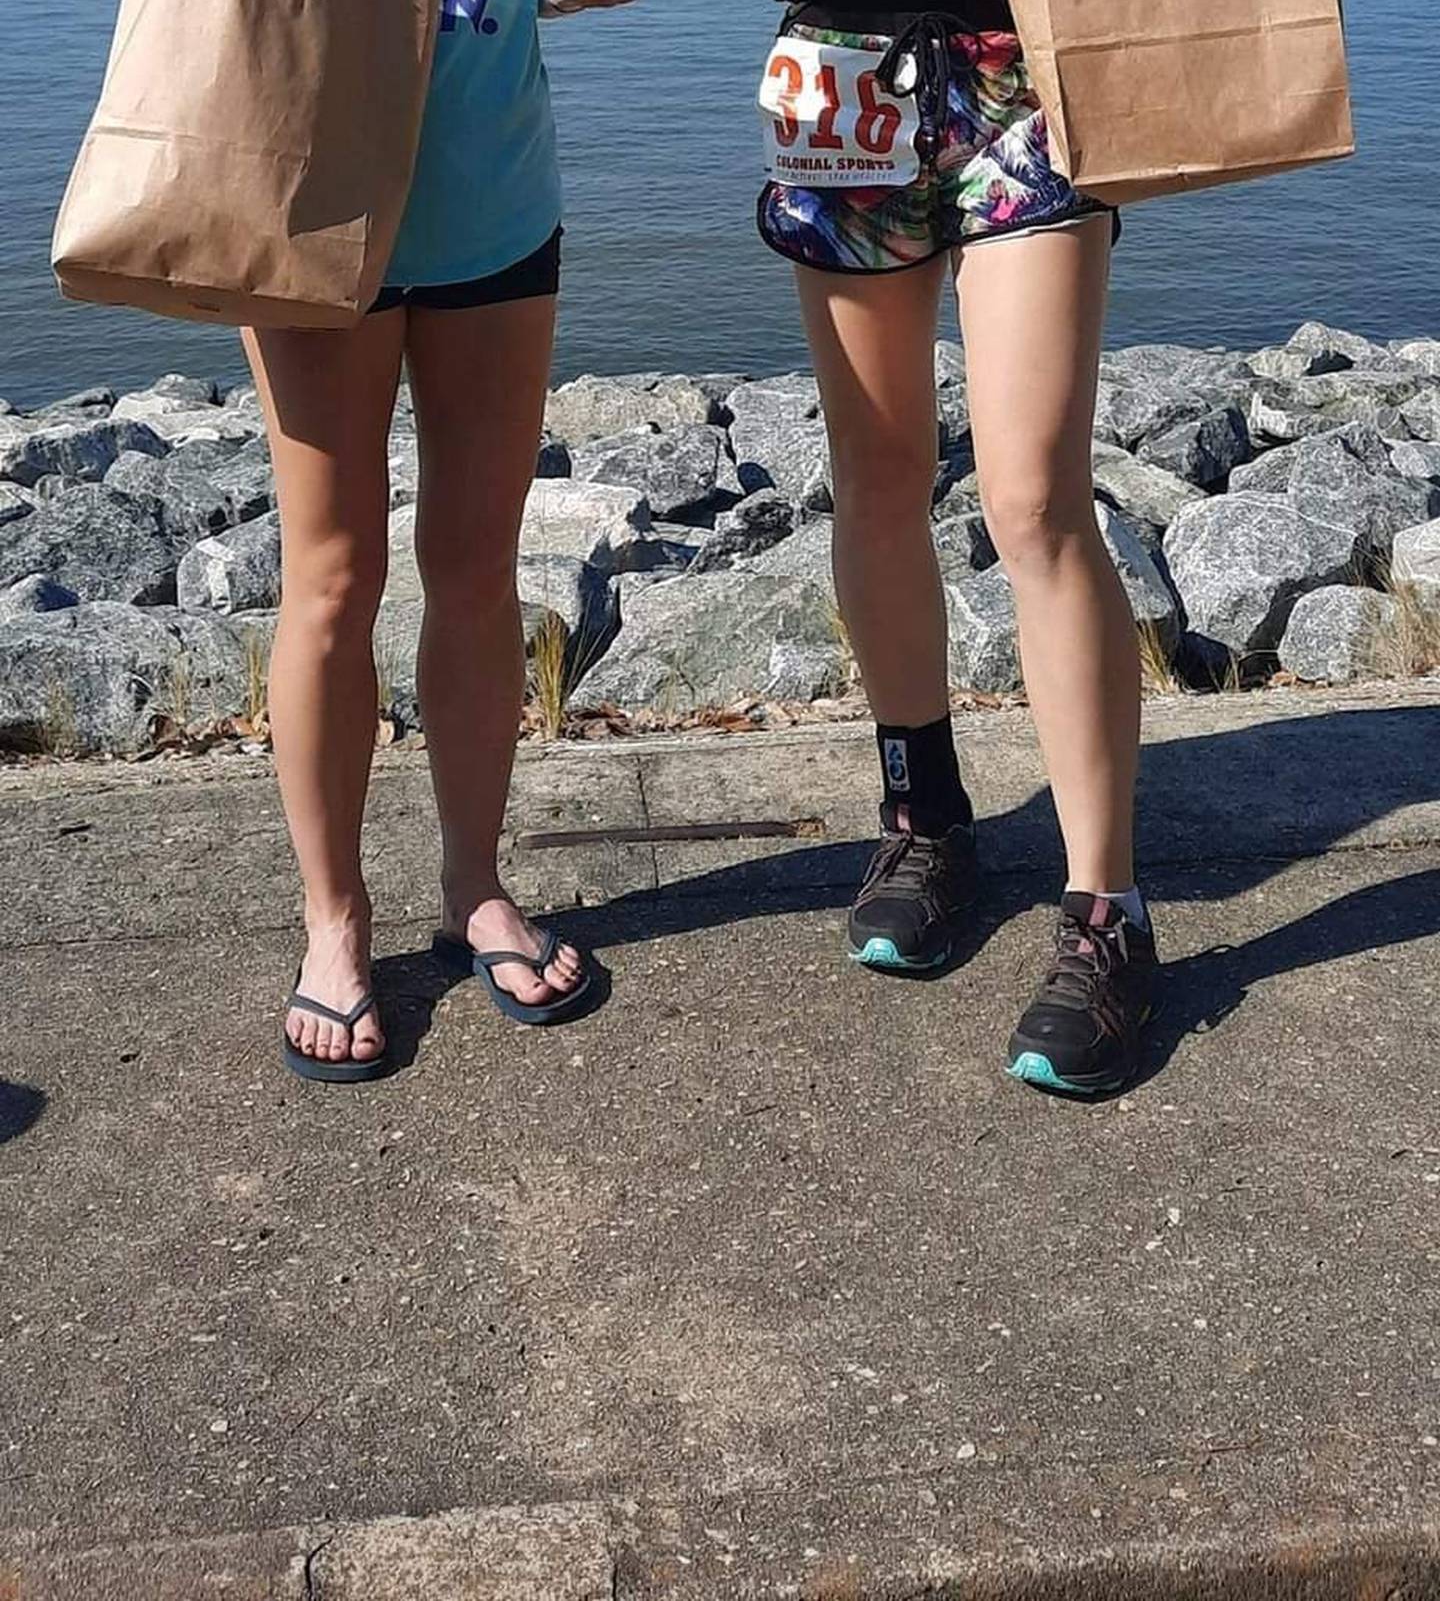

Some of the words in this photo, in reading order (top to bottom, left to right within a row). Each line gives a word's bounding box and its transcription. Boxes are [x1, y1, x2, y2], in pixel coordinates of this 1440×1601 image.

[768, 55, 901, 154] 316
[776, 154, 832, 171] COLONIAL
[837, 158, 894, 171] SPORTS
